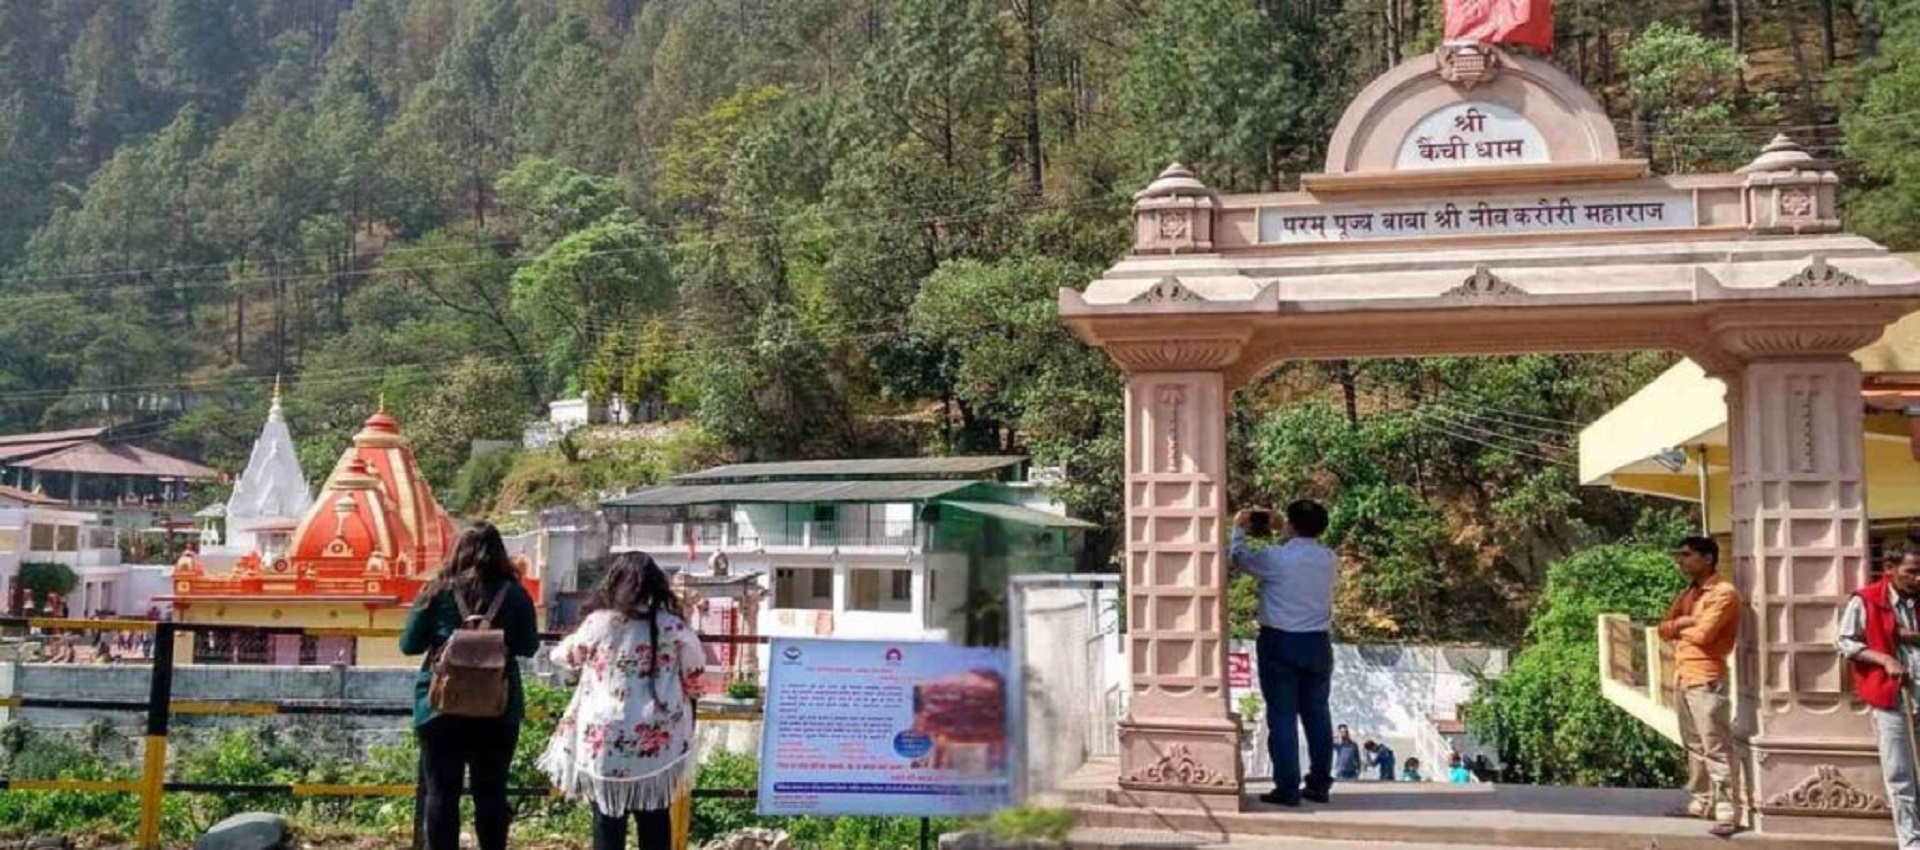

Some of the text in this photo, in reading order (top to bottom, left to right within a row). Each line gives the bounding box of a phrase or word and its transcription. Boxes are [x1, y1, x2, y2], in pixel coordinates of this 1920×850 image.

[1455, 107, 1487, 132] श्री
[1416, 135, 1524, 160] कैंची धाम
[1434, 203, 1463, 229] श्री
[1584, 203, 1664, 225] महाराज
